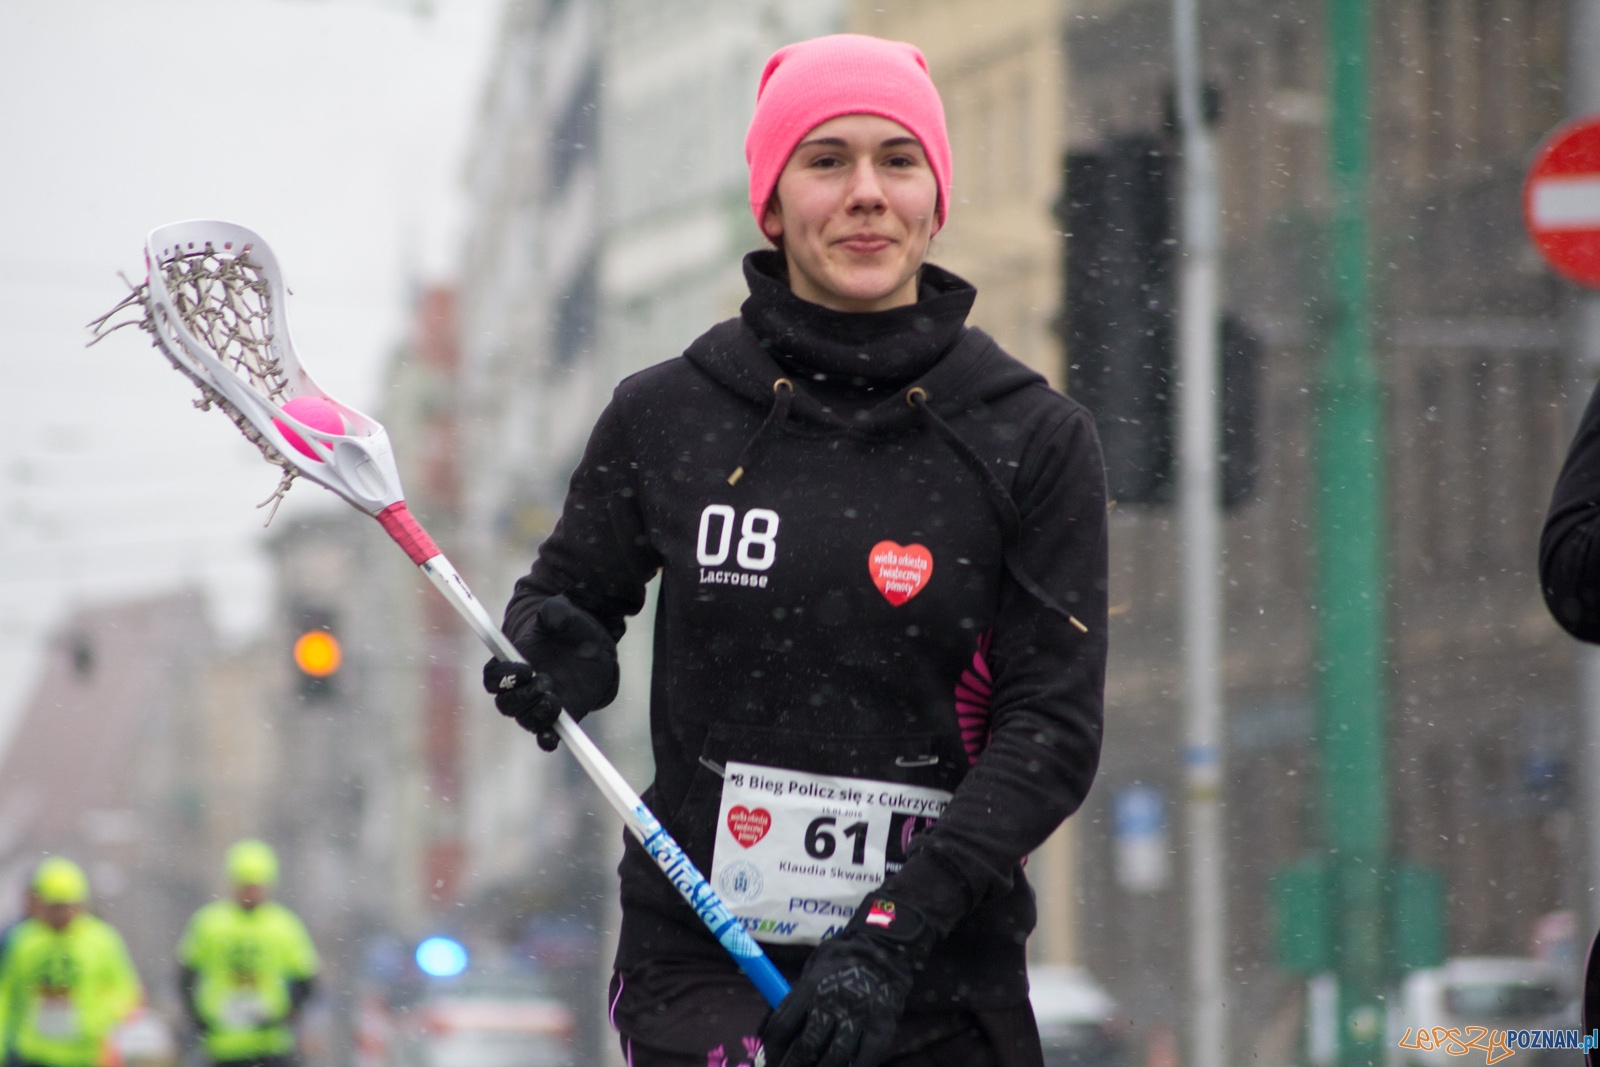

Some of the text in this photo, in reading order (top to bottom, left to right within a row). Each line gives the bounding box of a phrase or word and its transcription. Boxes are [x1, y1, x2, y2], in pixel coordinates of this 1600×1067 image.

[697, 504, 780, 571] 08
[700, 568, 768, 588] Lacrosse
[749, 775, 783, 796] Bieg
[788, 780, 835, 799] Policz
[867, 792, 875, 805] z
[804, 816, 869, 866] 61
[779, 861, 883, 883] Klaudia Skwarsk
[789, 897, 855, 918] POZna
